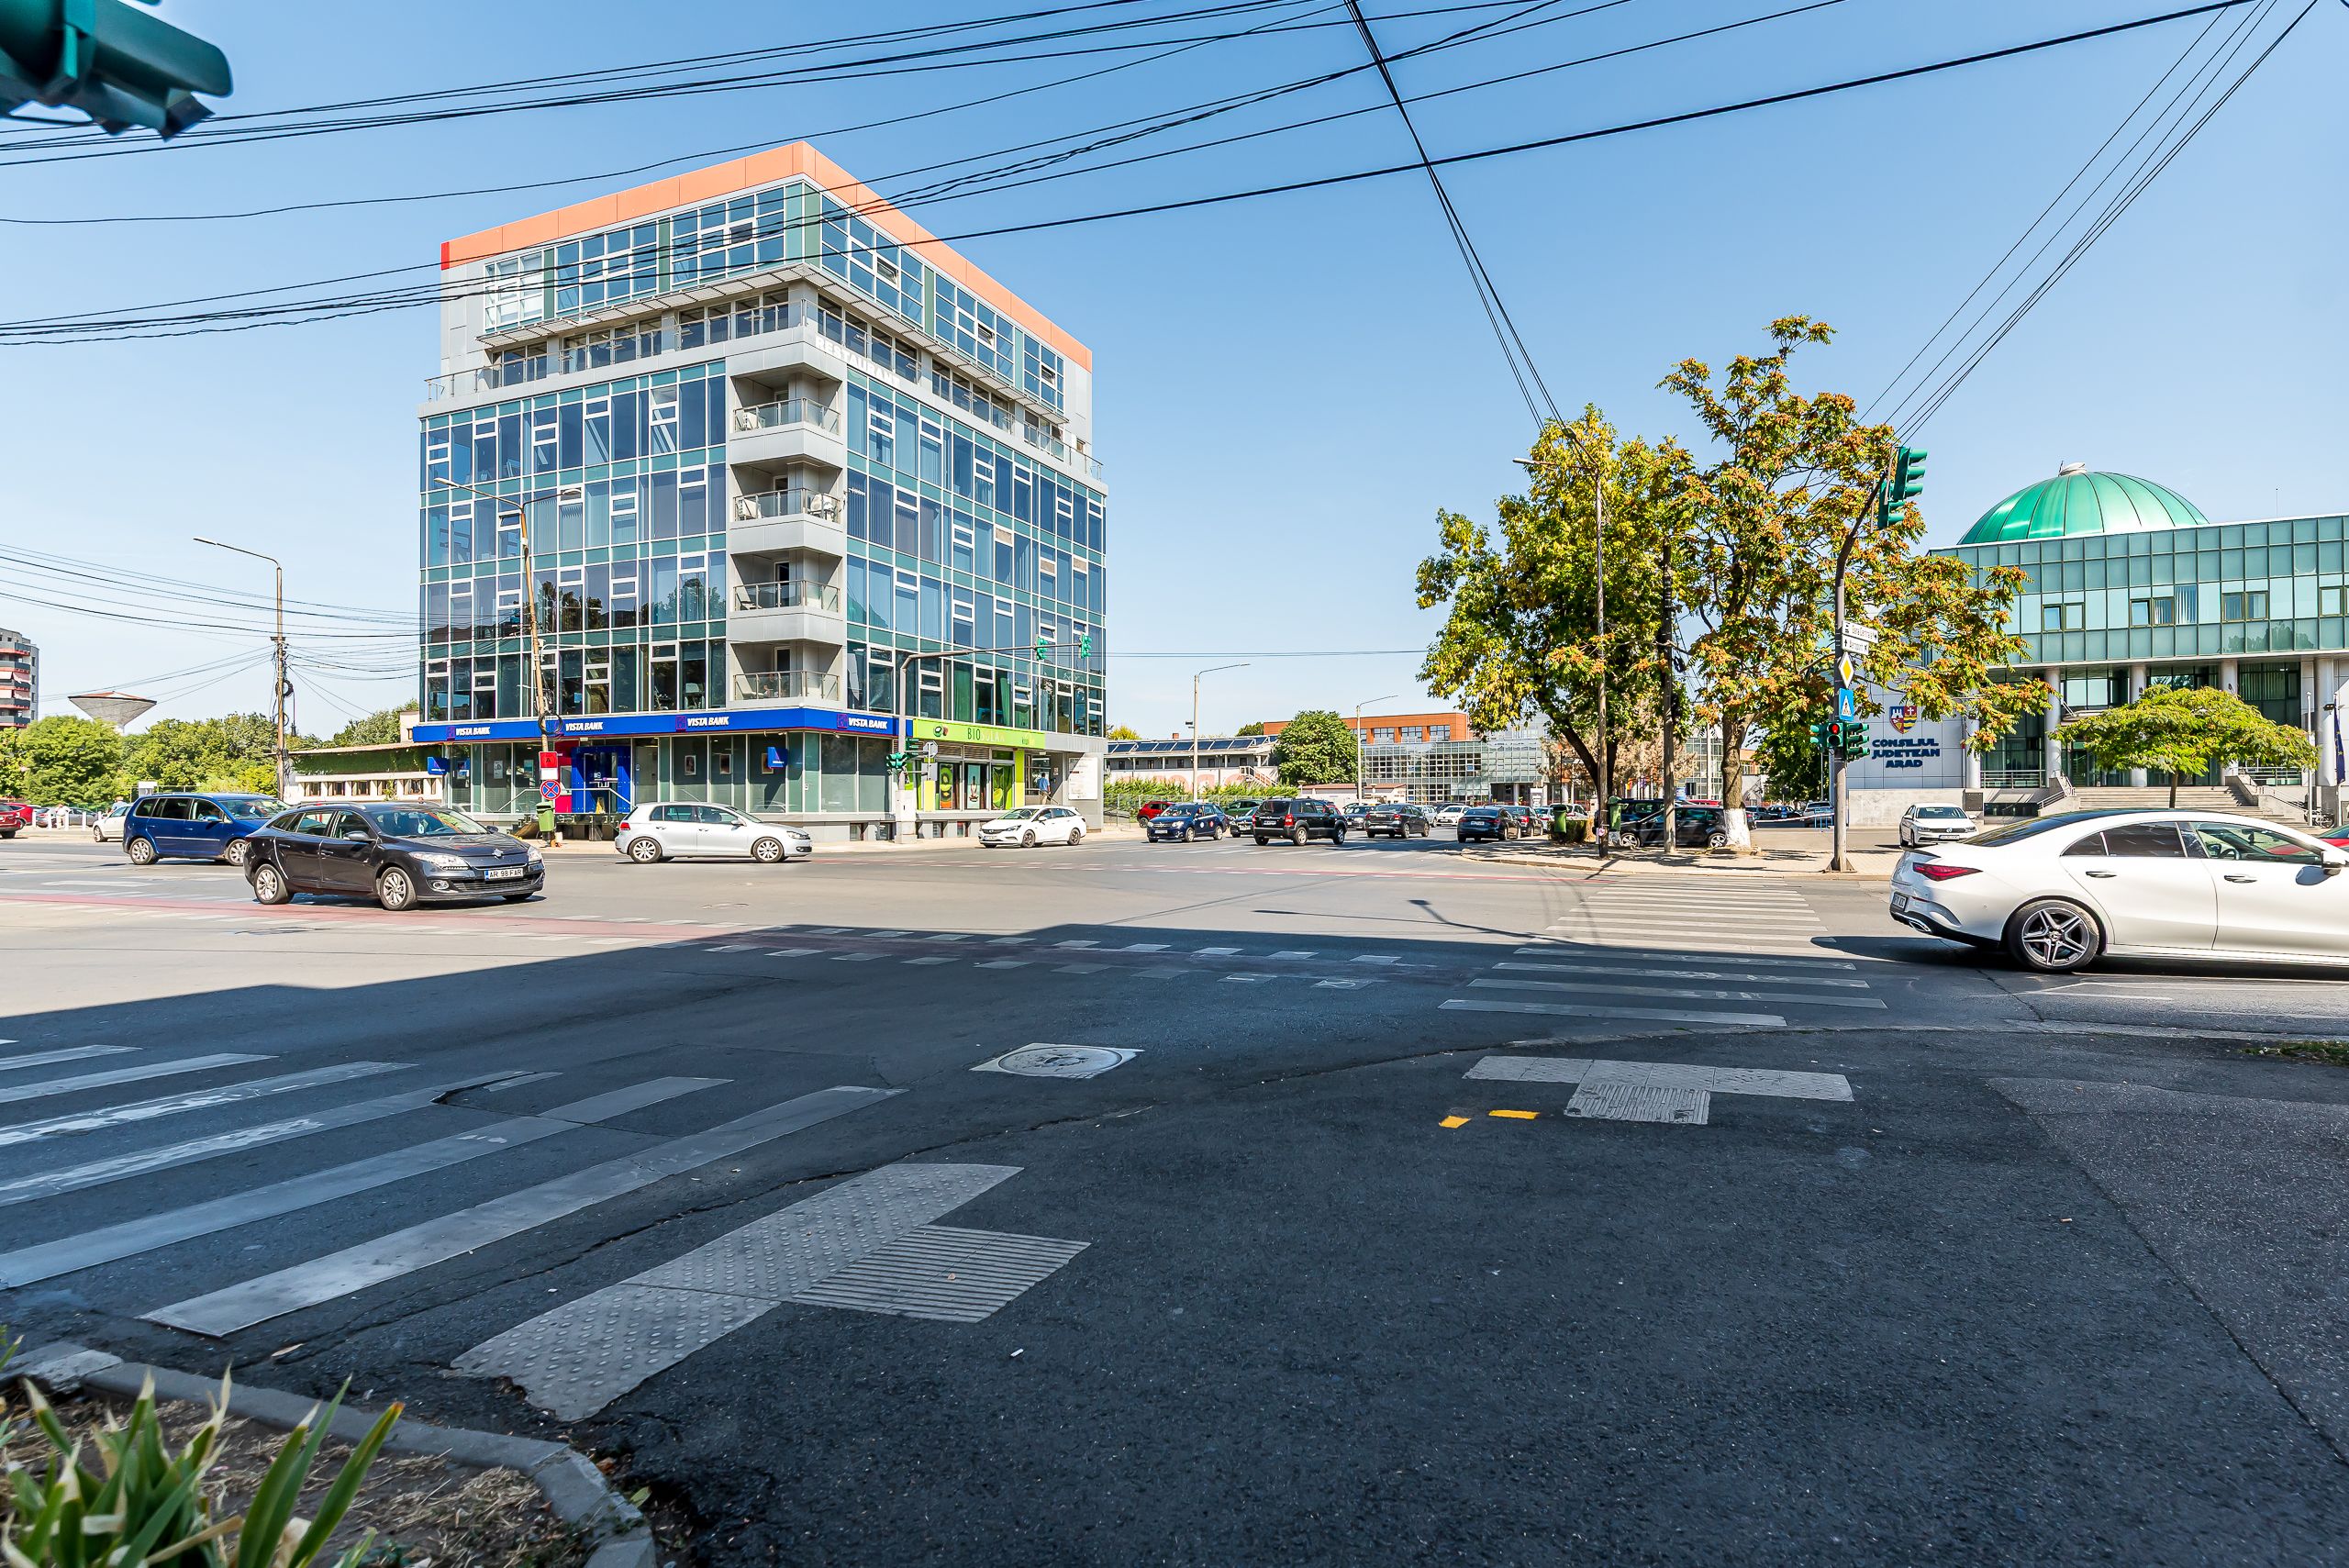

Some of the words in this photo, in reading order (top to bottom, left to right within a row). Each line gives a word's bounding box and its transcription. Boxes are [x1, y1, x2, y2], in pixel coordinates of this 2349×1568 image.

[816, 335, 900, 389] RESTAURANT
[565, 722, 584, 731] VISTA
[584, 721, 604, 731] BANK
[685, 717, 707, 727] VISTA
[707, 716, 729, 726] BANK
[848, 717, 868, 728] VISTA
[868, 719, 888, 730] BANK
[455, 728, 473, 736] VISTA
[473, 726, 491, 735] BANK
[1872, 738, 1939, 748] CONSILIUL
[1886, 760, 1923, 769] ARAD
